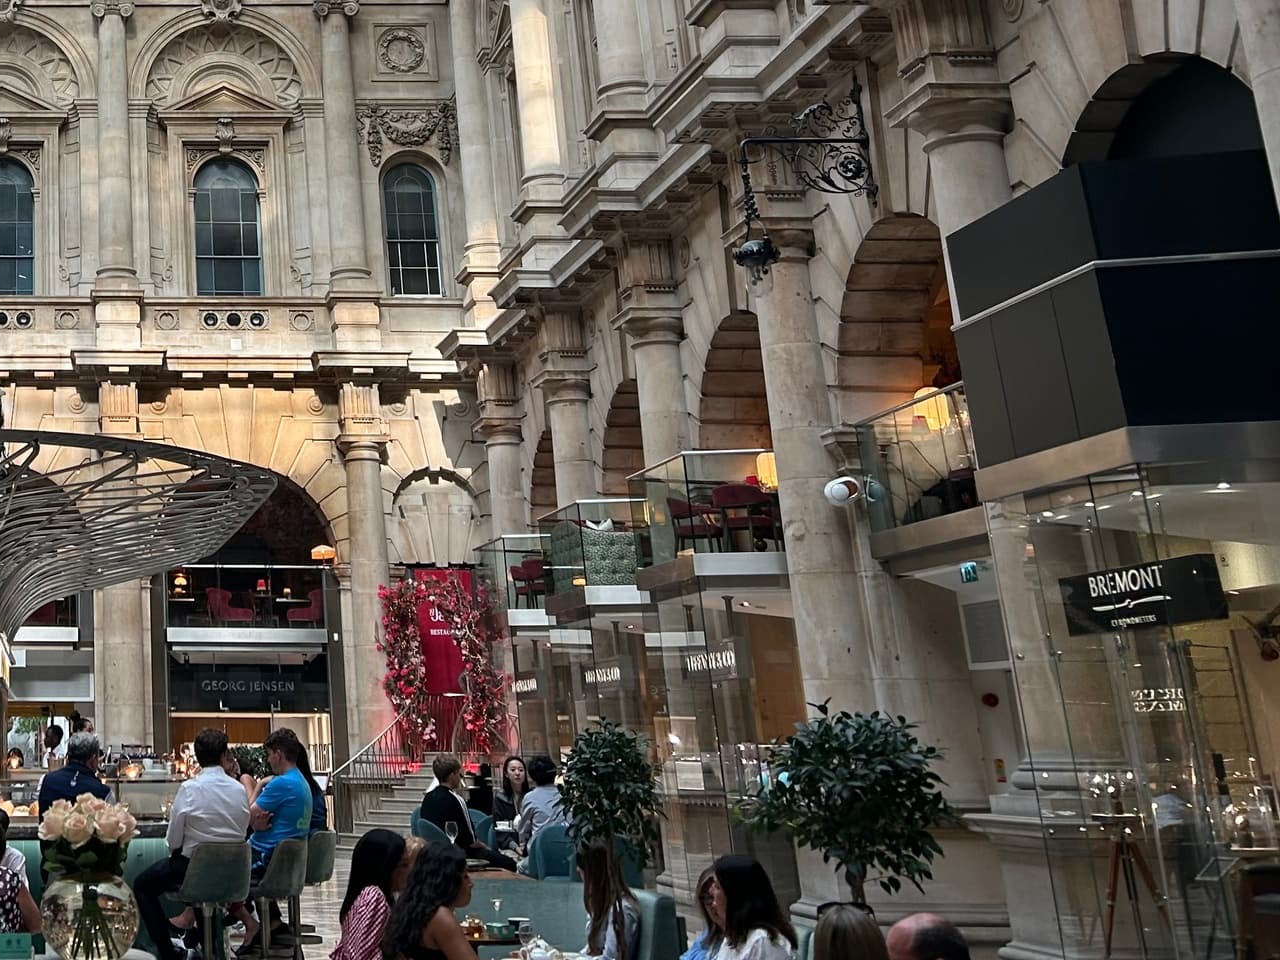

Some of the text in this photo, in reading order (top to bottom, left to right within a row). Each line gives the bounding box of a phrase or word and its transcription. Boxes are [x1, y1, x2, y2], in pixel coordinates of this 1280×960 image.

[1087, 565, 1163, 598] BREMONT
[201, 680, 295, 692] GEORG JENSEN
